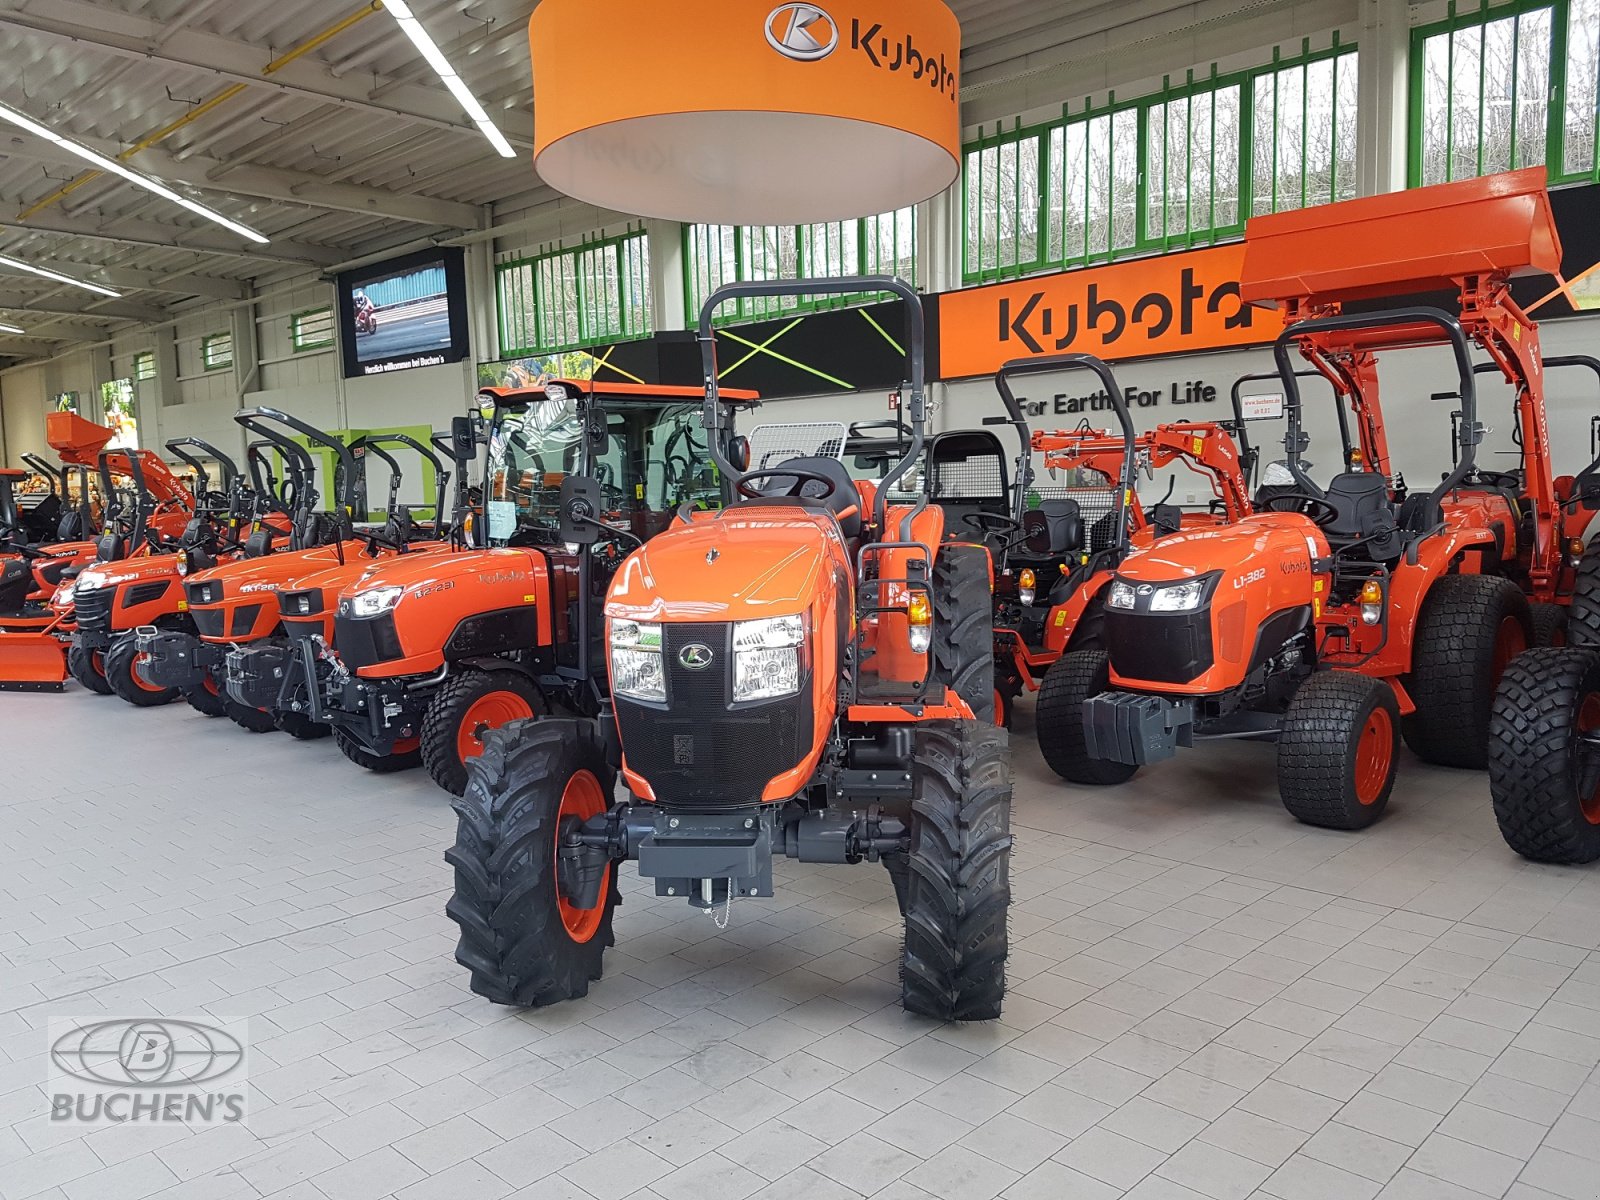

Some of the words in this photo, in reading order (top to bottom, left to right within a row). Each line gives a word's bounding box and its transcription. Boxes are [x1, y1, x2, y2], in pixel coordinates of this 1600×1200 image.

[851, 18, 956, 103] Kubota
[998, 267, 1253, 354] Kubota
[364, 364, 384, 374] Herzlich
[384, 361, 411, 371] willkommen
[412, 358, 420, 367] bei
[1016, 397, 1048, 416] For
[1124, 386, 1161, 408] For
[1171, 380, 1217, 404] Life
[1539, 399, 1549, 458] Kubota
[170, 478, 189, 501] Kubota
[1233, 567, 1266, 590] L1-382
[1280, 559, 1308, 575] Kubota
[414, 580, 455, 600] B2-231
